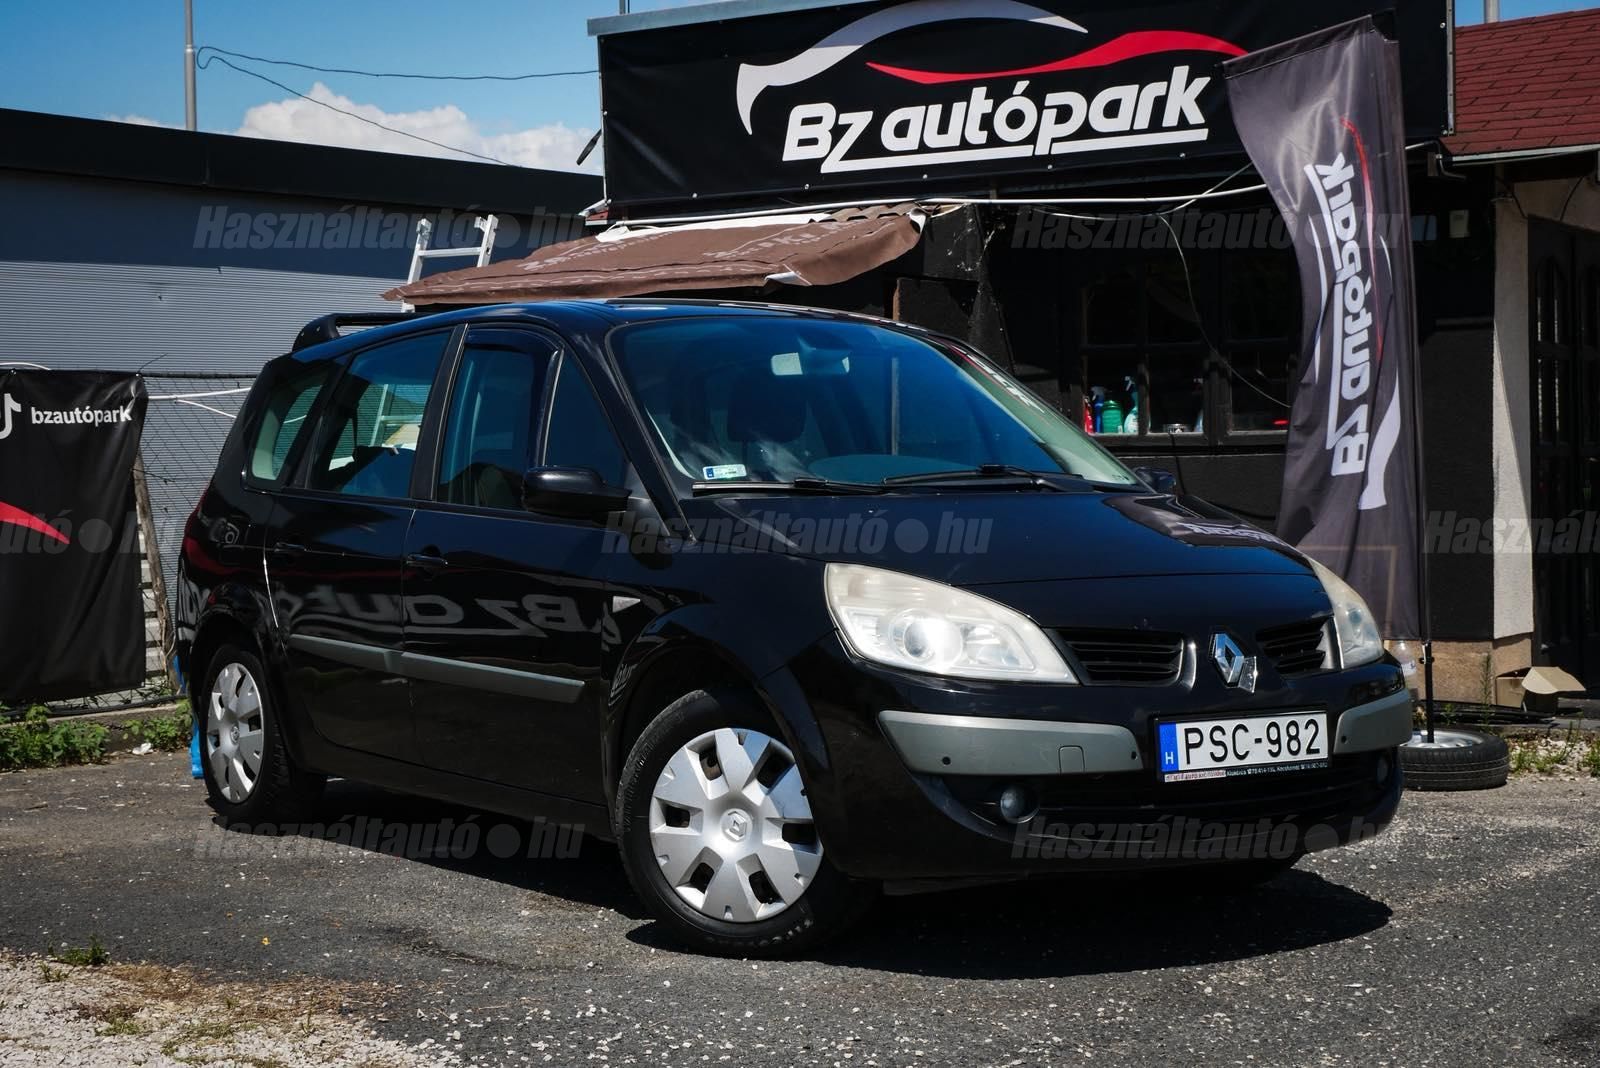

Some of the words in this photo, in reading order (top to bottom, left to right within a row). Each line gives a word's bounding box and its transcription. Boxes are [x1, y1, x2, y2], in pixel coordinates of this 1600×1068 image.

[881, 65, 1211, 156] autópark
[31, 406, 132, 427] bzautópark
[1165, 751, 1174, 765] H
[1184, 718, 1321, 765] PSC-982
